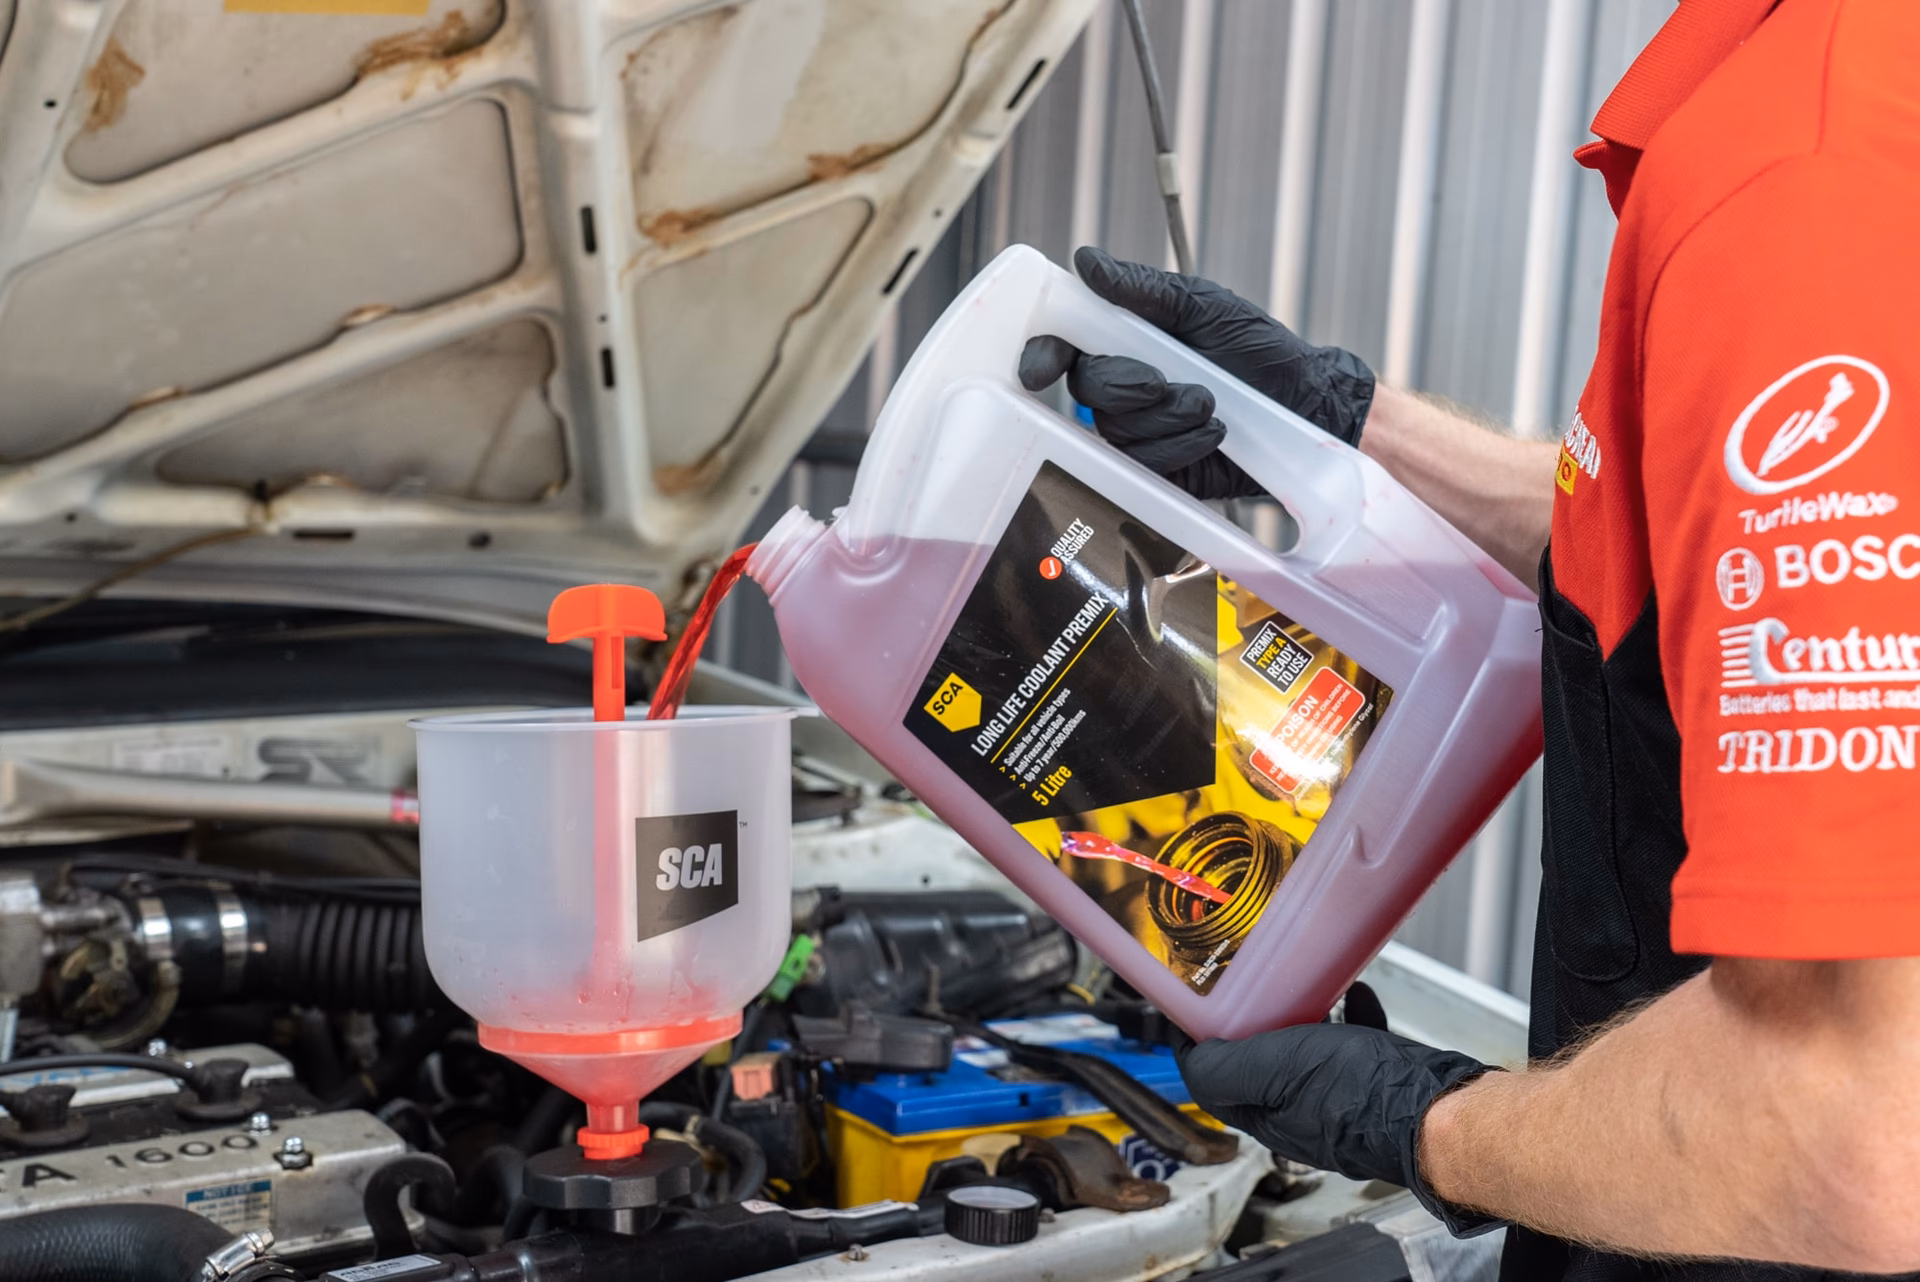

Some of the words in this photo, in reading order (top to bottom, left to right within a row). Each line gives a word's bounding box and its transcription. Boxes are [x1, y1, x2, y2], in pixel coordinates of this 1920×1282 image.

[1050, 517, 1084, 558] QUALITY
[1060, 525, 1094, 566] ASSURED
[1774, 533, 1920, 588] BOSC
[1246, 628, 1277, 663] PREMIX
[1256, 644, 1280, 669] TYPE
[1275, 637, 1286, 648] A
[1266, 643, 1296, 679] READY
[971, 719, 1006, 756] LONG
[996, 692, 1027, 725] LIFE
[1018, 637, 1070, 698] COOLANT
[1062, 592, 1109, 644] PREMIX
[1277, 670, 1294, 686] TO
[1287, 652, 1308, 674] USE
[932, 682, 963, 715] SCA
[1052, 688, 1071, 707] types
[1720, 692, 1792, 716] Batteries
[1794, 687, 1837, 712] that
[1838, 686, 1881, 711] last
[1031, 724, 1040, 734] all
[1036, 705, 1057, 728] vehicle
[1274, 693, 1319, 744] POISON
[1026, 729, 1037, 741] for
[1717, 725, 1920, 774] TRIDON
[1003, 736, 1032, 767] Suitable
[1035, 758, 1044, 767] 7
[1023, 771, 1036, 782] Up
[1030, 765, 1041, 774] to
[1040, 766, 1072, 796] Litre
[1032, 790, 1049, 806] 5
[656, 843, 722, 891] SCA
[105, 1134, 258, 1169] 1600
